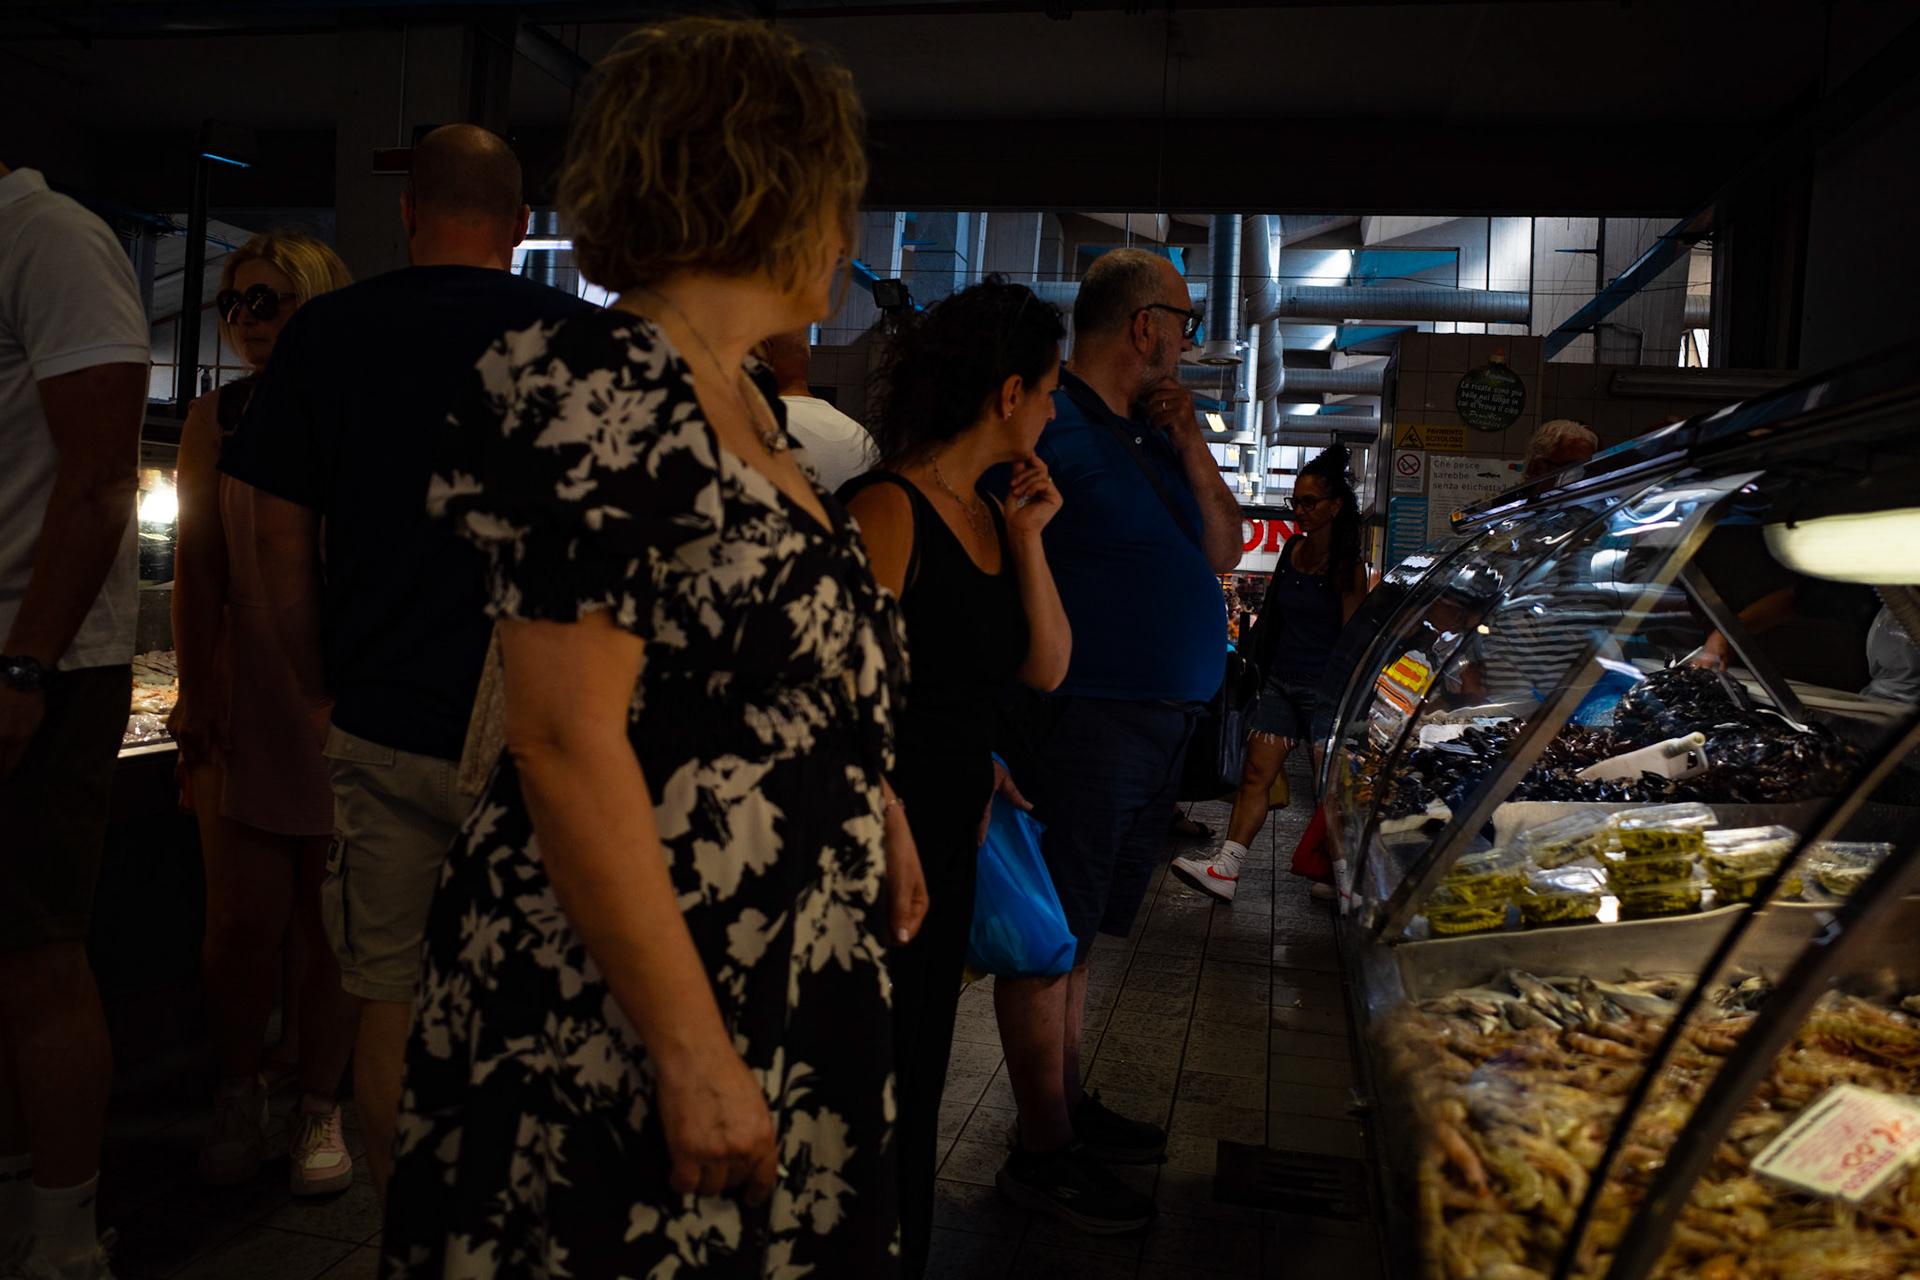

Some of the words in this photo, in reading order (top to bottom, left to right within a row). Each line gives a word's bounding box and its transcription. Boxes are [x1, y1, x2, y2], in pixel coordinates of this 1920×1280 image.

[1426, 428, 1463, 436] PAVIMENTO
[1425, 435, 1463, 443] SCIVOLOSO
[1433, 459, 1451, 468] Che
[1453, 462, 1480, 470] pesce
[1433, 472, 1470, 480] sarebbe
[1432, 482, 1459, 490] senza
